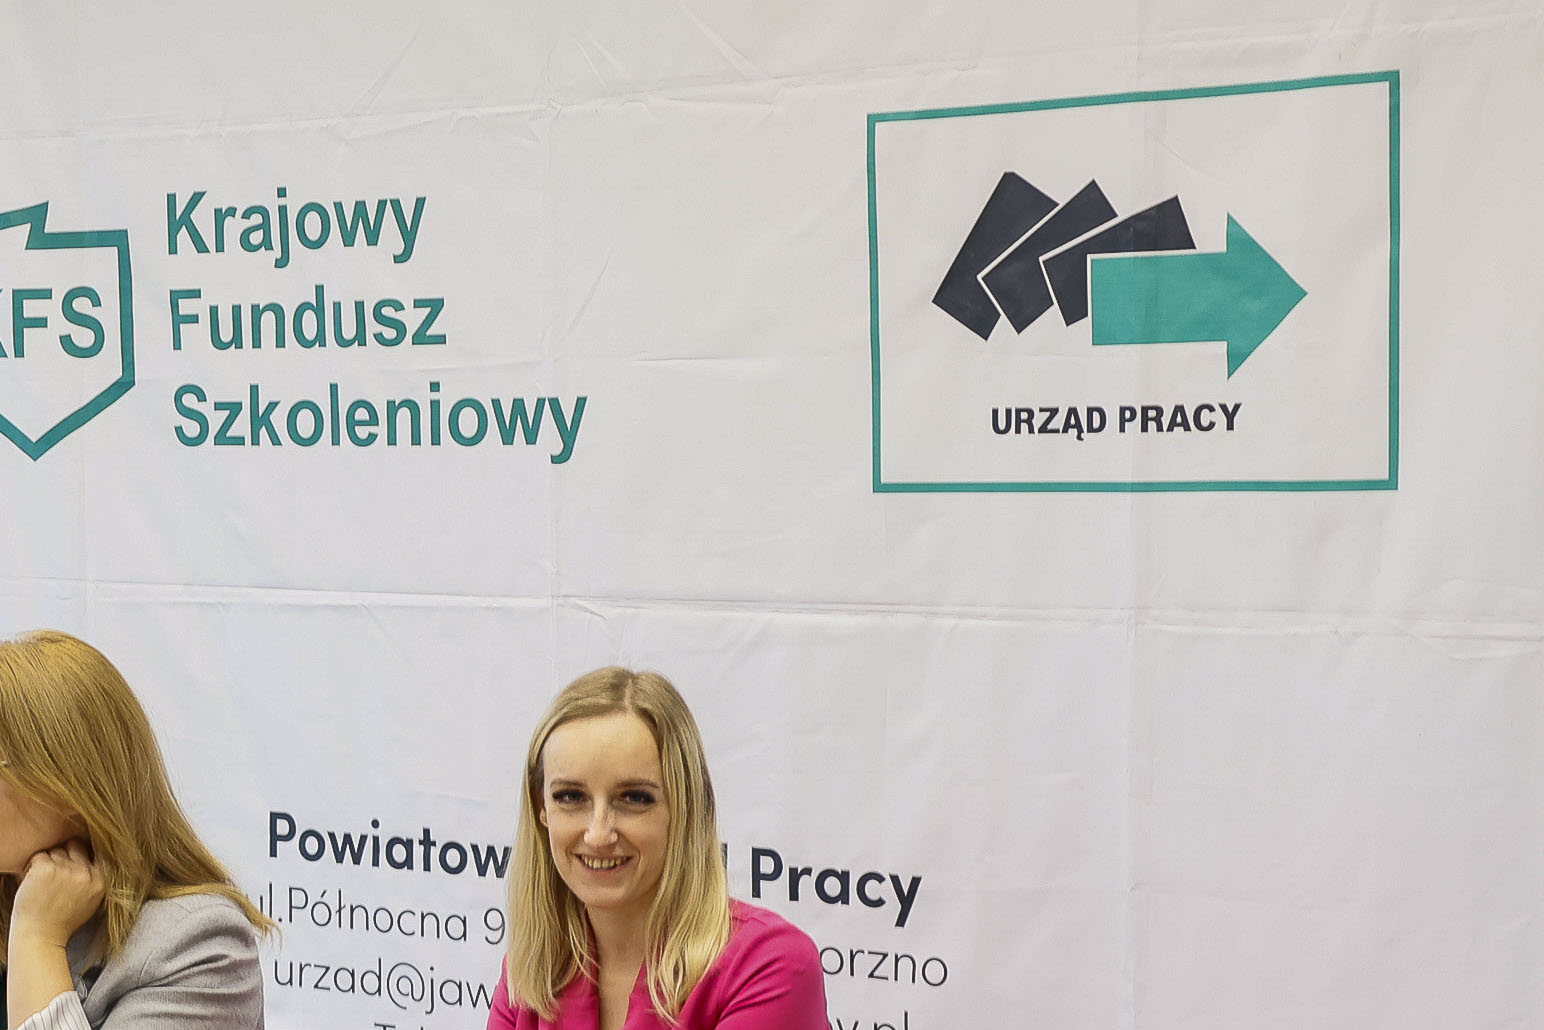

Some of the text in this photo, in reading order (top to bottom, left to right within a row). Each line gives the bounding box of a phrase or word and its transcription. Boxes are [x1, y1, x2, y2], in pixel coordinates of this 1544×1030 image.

[166, 187, 426, 268] Krajowy
[169, 284, 447, 350] Fundusz
[174, 381, 587, 464] Szkoleniowy
[991, 402, 1242, 441] URZĄD PRACY
[267, 811, 923, 928] Powiatow Pracy
[274, 957, 497, 1015] urzad@jaw
[819, 947, 948, 987] orzno
